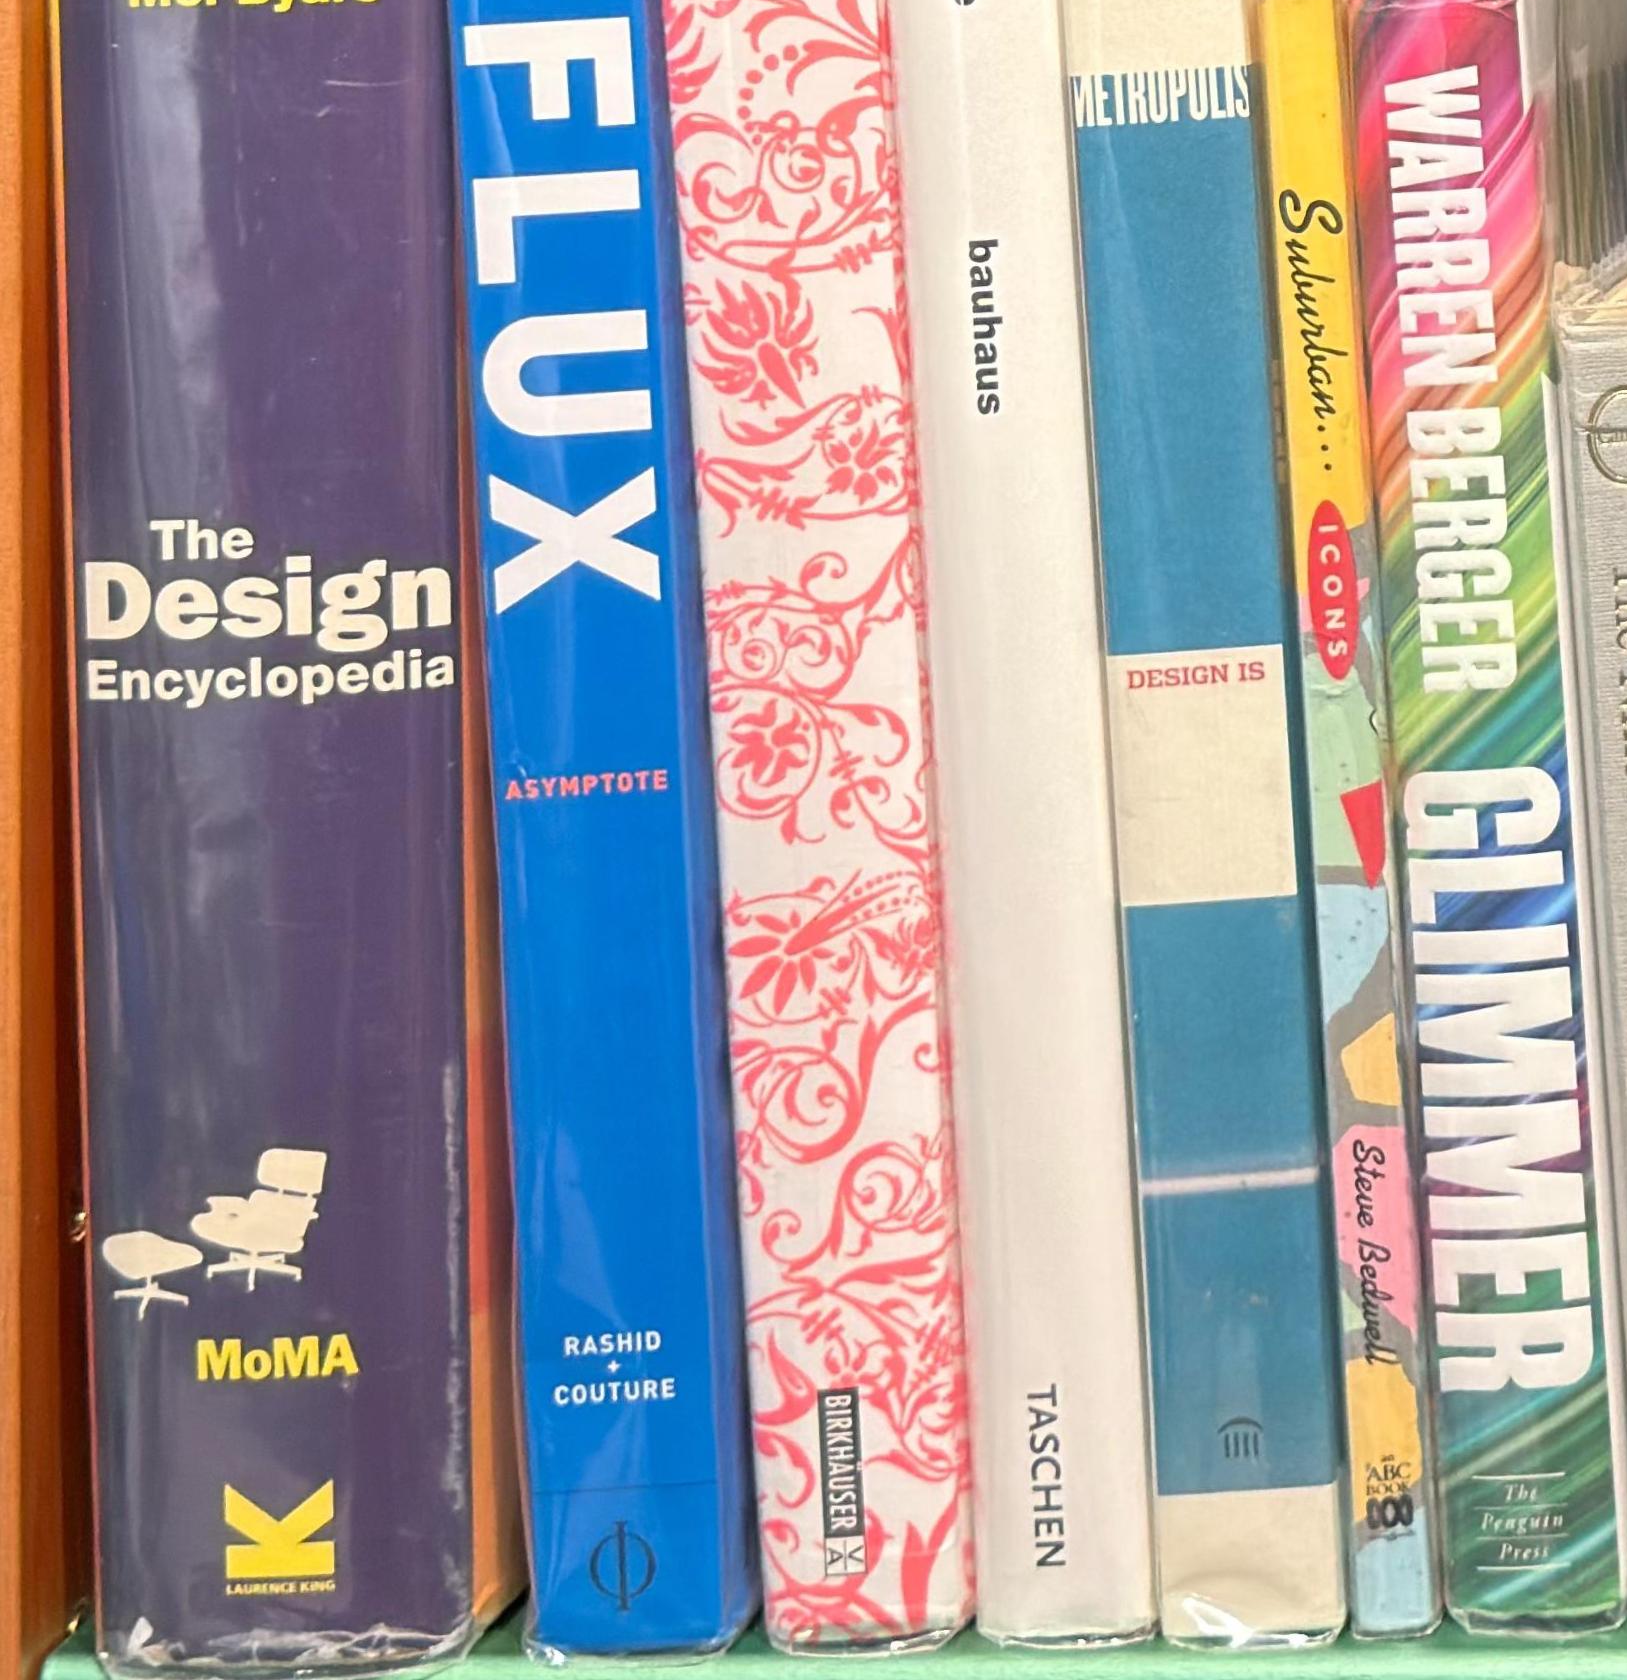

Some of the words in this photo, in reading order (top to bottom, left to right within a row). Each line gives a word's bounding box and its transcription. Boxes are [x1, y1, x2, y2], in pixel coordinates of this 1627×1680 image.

[1071, 64, 1251, 128] METROPOLIS
[1384, 64, 1502, 389] WARREN
[463, 15, 662, 615] FLUX
[968, 238, 1003, 415] bauhaus
[150, 520, 255, 562] The
[1405, 405, 1519, 695] BERGER
[83, 555, 454, 655] Design
[1316, 523, 1349, 658] ICONS
[86, 649, 456, 708] Encyclopedia
[1126, 664, 1230, 690] DESIGN
[1237, 660, 1266, 683] IS
[505, 769, 670, 801] ASYMPTOTE
[1401, 765, 1595, 1394] GLIMMER
[1352, 1137, 1386, 1229] Steve
[1356, 1236, 1402, 1367] Bedwell
[196, 1333, 359, 1382] MoMA
[563, 1329, 662, 1358] RASHID
[553, 1377, 677, 1405] COUTURE
[824, 1394, 863, 1531] BIRKHÄUSER
[1026, 1382, 1067, 1568] TASCHEN
[1366, 1462, 1412, 1481] ABC
[1504, 1483, 1538, 1502] The
[1481, 1512, 1564, 1535] Penguin
[1499, 1542, 1551, 1561] Press
